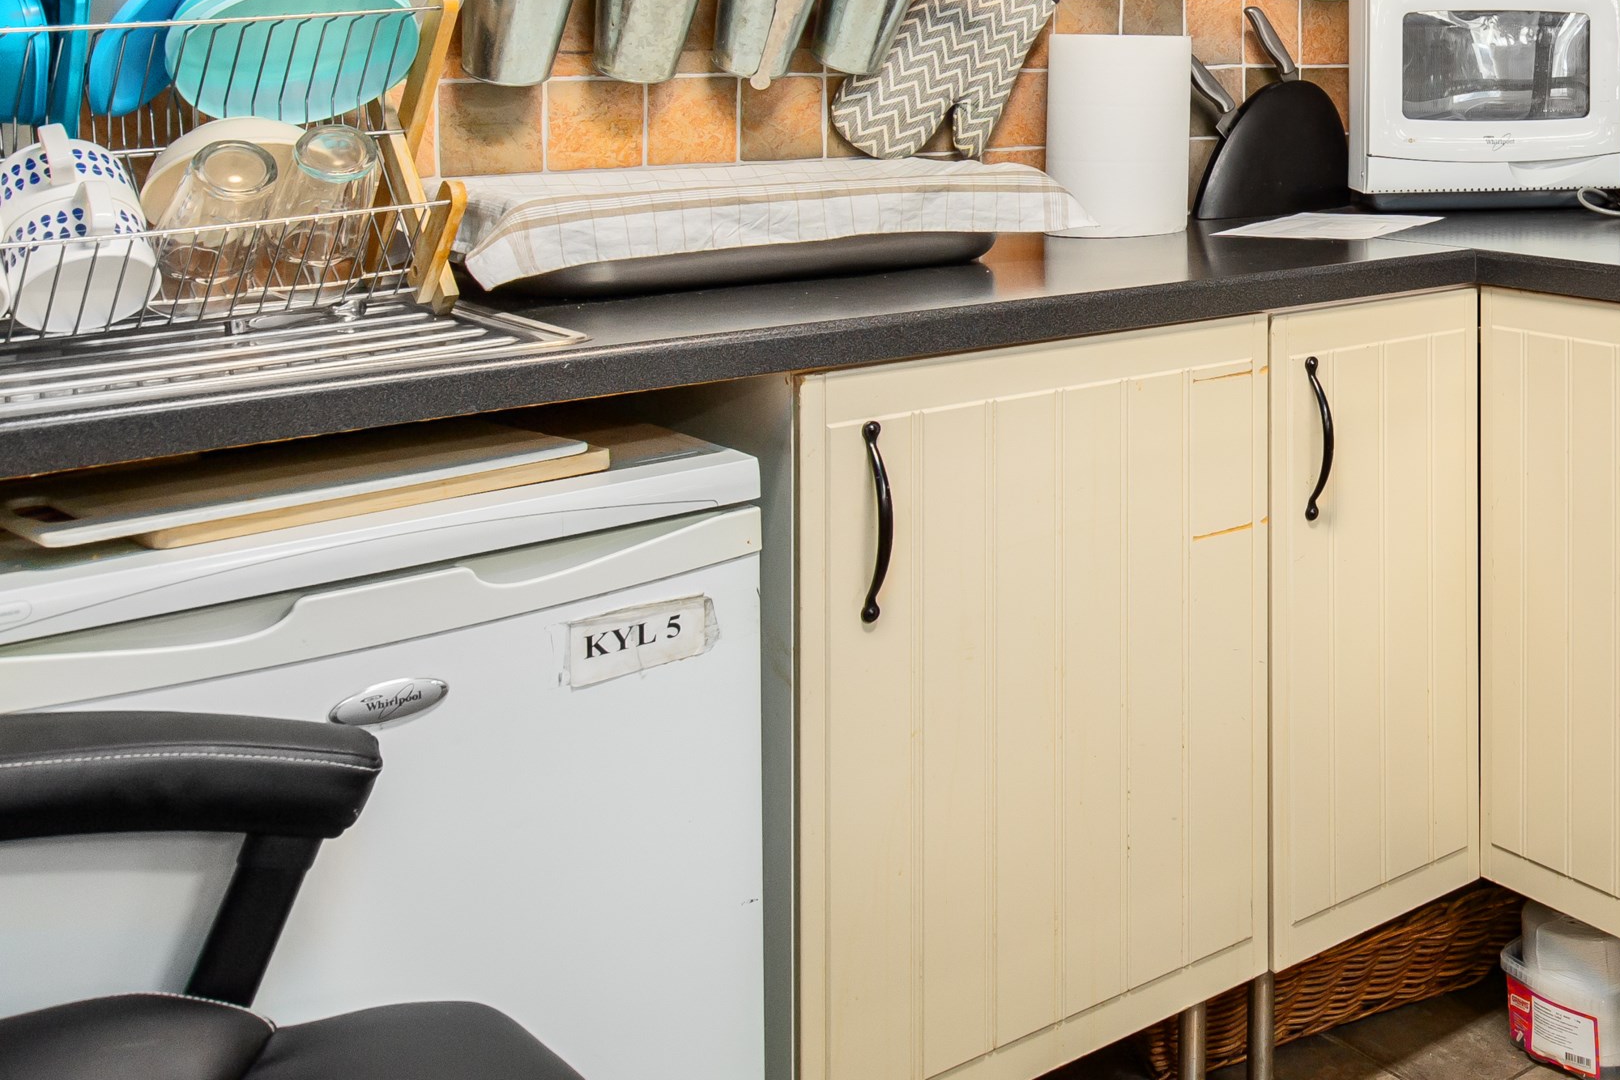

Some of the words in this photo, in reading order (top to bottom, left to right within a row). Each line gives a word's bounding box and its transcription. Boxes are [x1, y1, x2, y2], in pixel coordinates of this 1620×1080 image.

[1485, 137, 1515, 146] Whirlpool
[584, 623, 657, 661] KYL
[666, 614, 682, 640] 5
[365, 690, 422, 712] Whirlpool
